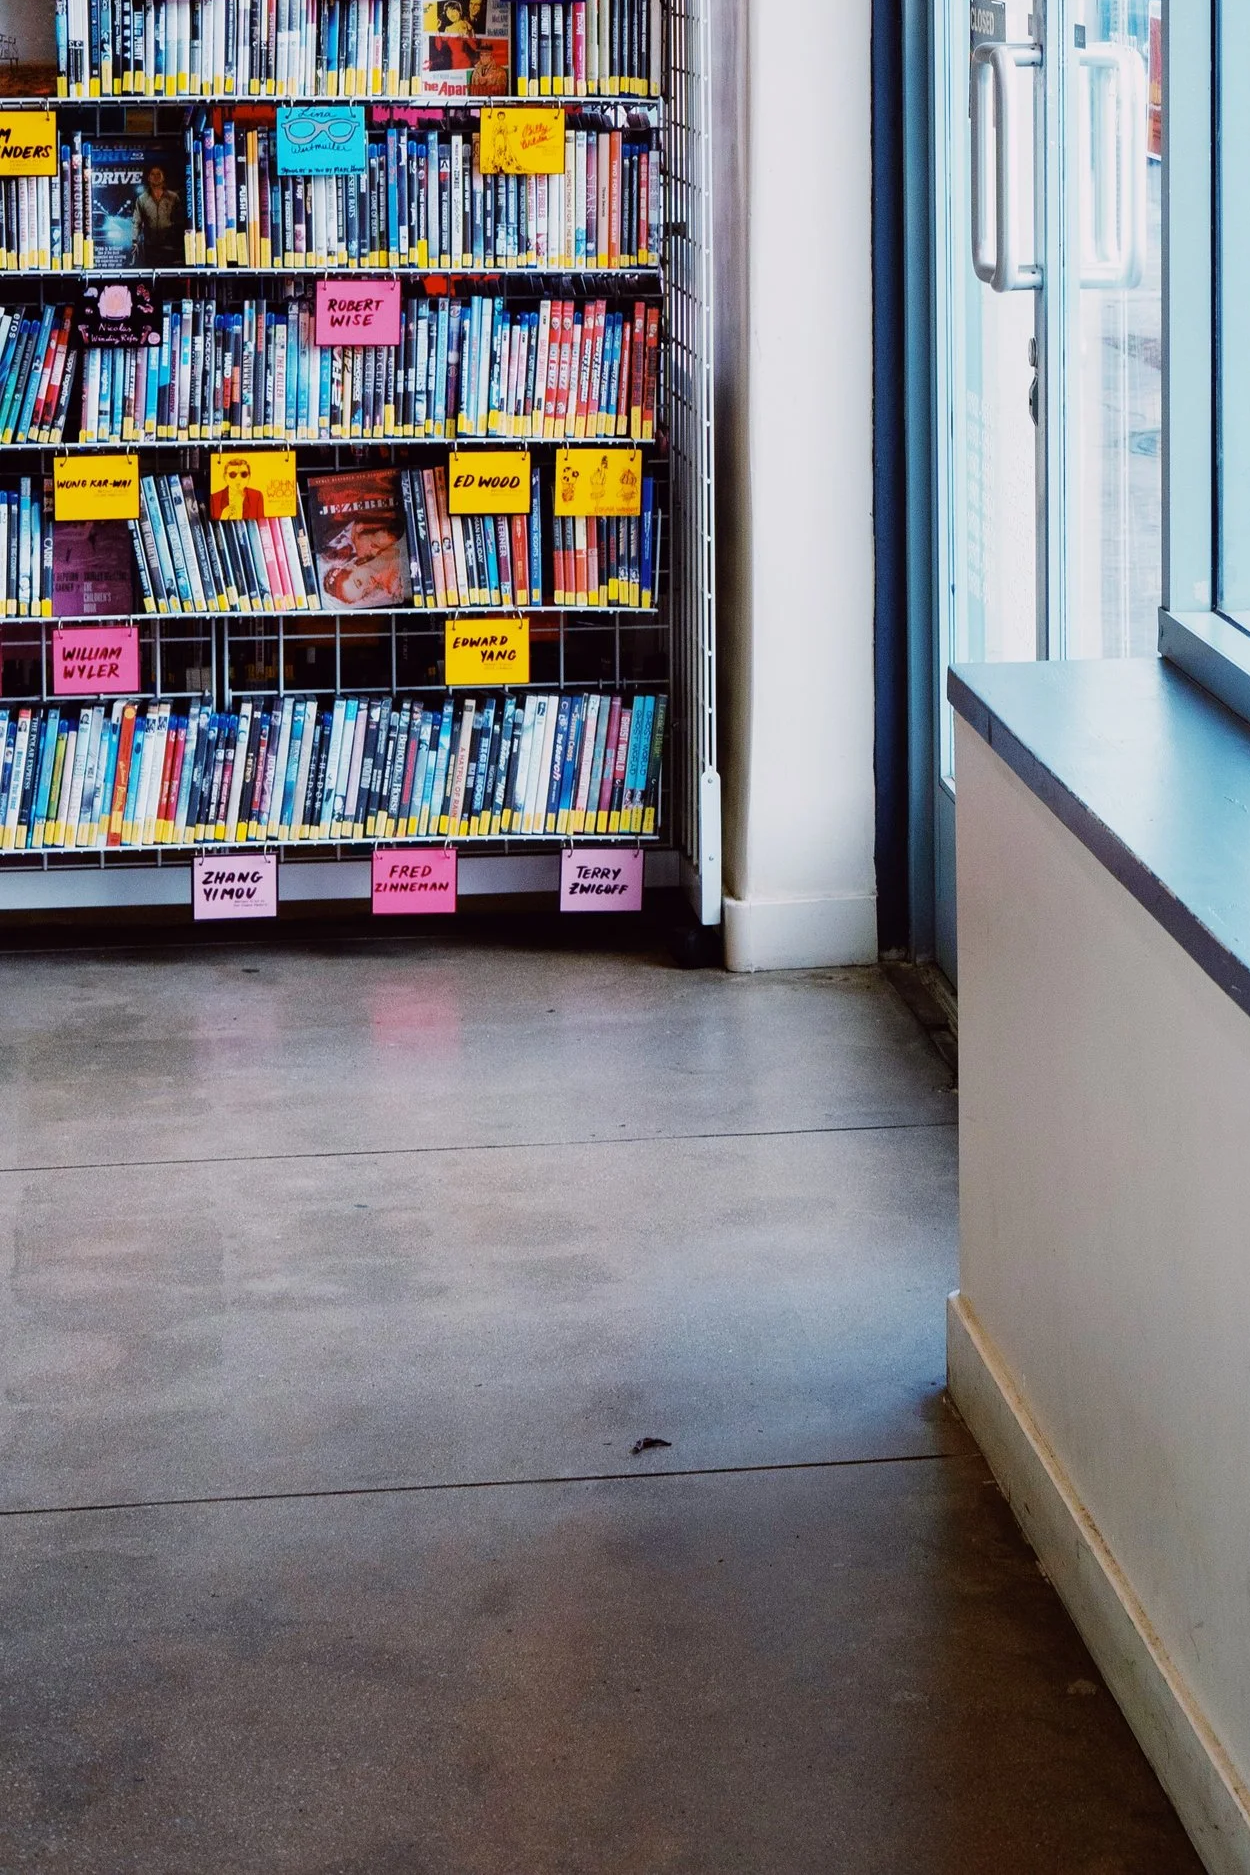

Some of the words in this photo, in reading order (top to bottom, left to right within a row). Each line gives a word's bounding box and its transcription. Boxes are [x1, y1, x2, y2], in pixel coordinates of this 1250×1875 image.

[970, 7, 995, 36] CLOSED
[298, 107, 338, 118] Lina
[522, 122, 553, 137] Billy
[0, 145, 53, 159] NDERS
[92, 171, 144, 185] DRIVE
[586, 174, 596, 219] STAR!
[327, 298, 384, 313] ROBERT
[8, 313, 21, 339] eros
[98, 323, 133, 333] Nicolas
[330, 314, 375, 327] WISE
[91, 334, 119, 344] Winding
[60, 374, 71, 406] together
[57, 479, 87, 489] WONG
[89, 479, 132, 488] KAR-WAI
[268, 479, 295, 489] JOHN
[453, 475, 475, 489] ED
[477, 475, 521, 489] WOOD
[319, 496, 399, 516] JEZEBEL
[143, 520, 152, 534] THE
[167, 524, 183, 547] DEAD
[43, 538, 52, 569] CARRIE
[145, 535, 157, 568] COLLECTOR
[83, 592, 112, 602] CHILDREN'S
[452, 635, 508, 649] EDWARD
[62, 647, 122, 662] WILLIAM
[480, 650, 517, 663] YANG
[63, 663, 120, 679] WYLER
[202, 870, 264, 887] ZHANG
[389, 864, 432, 880] FRED
[576, 865, 623, 881] TERRY
[203, 886, 257, 902] YIMOU
[374, 881, 450, 894] ZINNEMAN
[568, 882, 630, 896] ZWIGOFF
